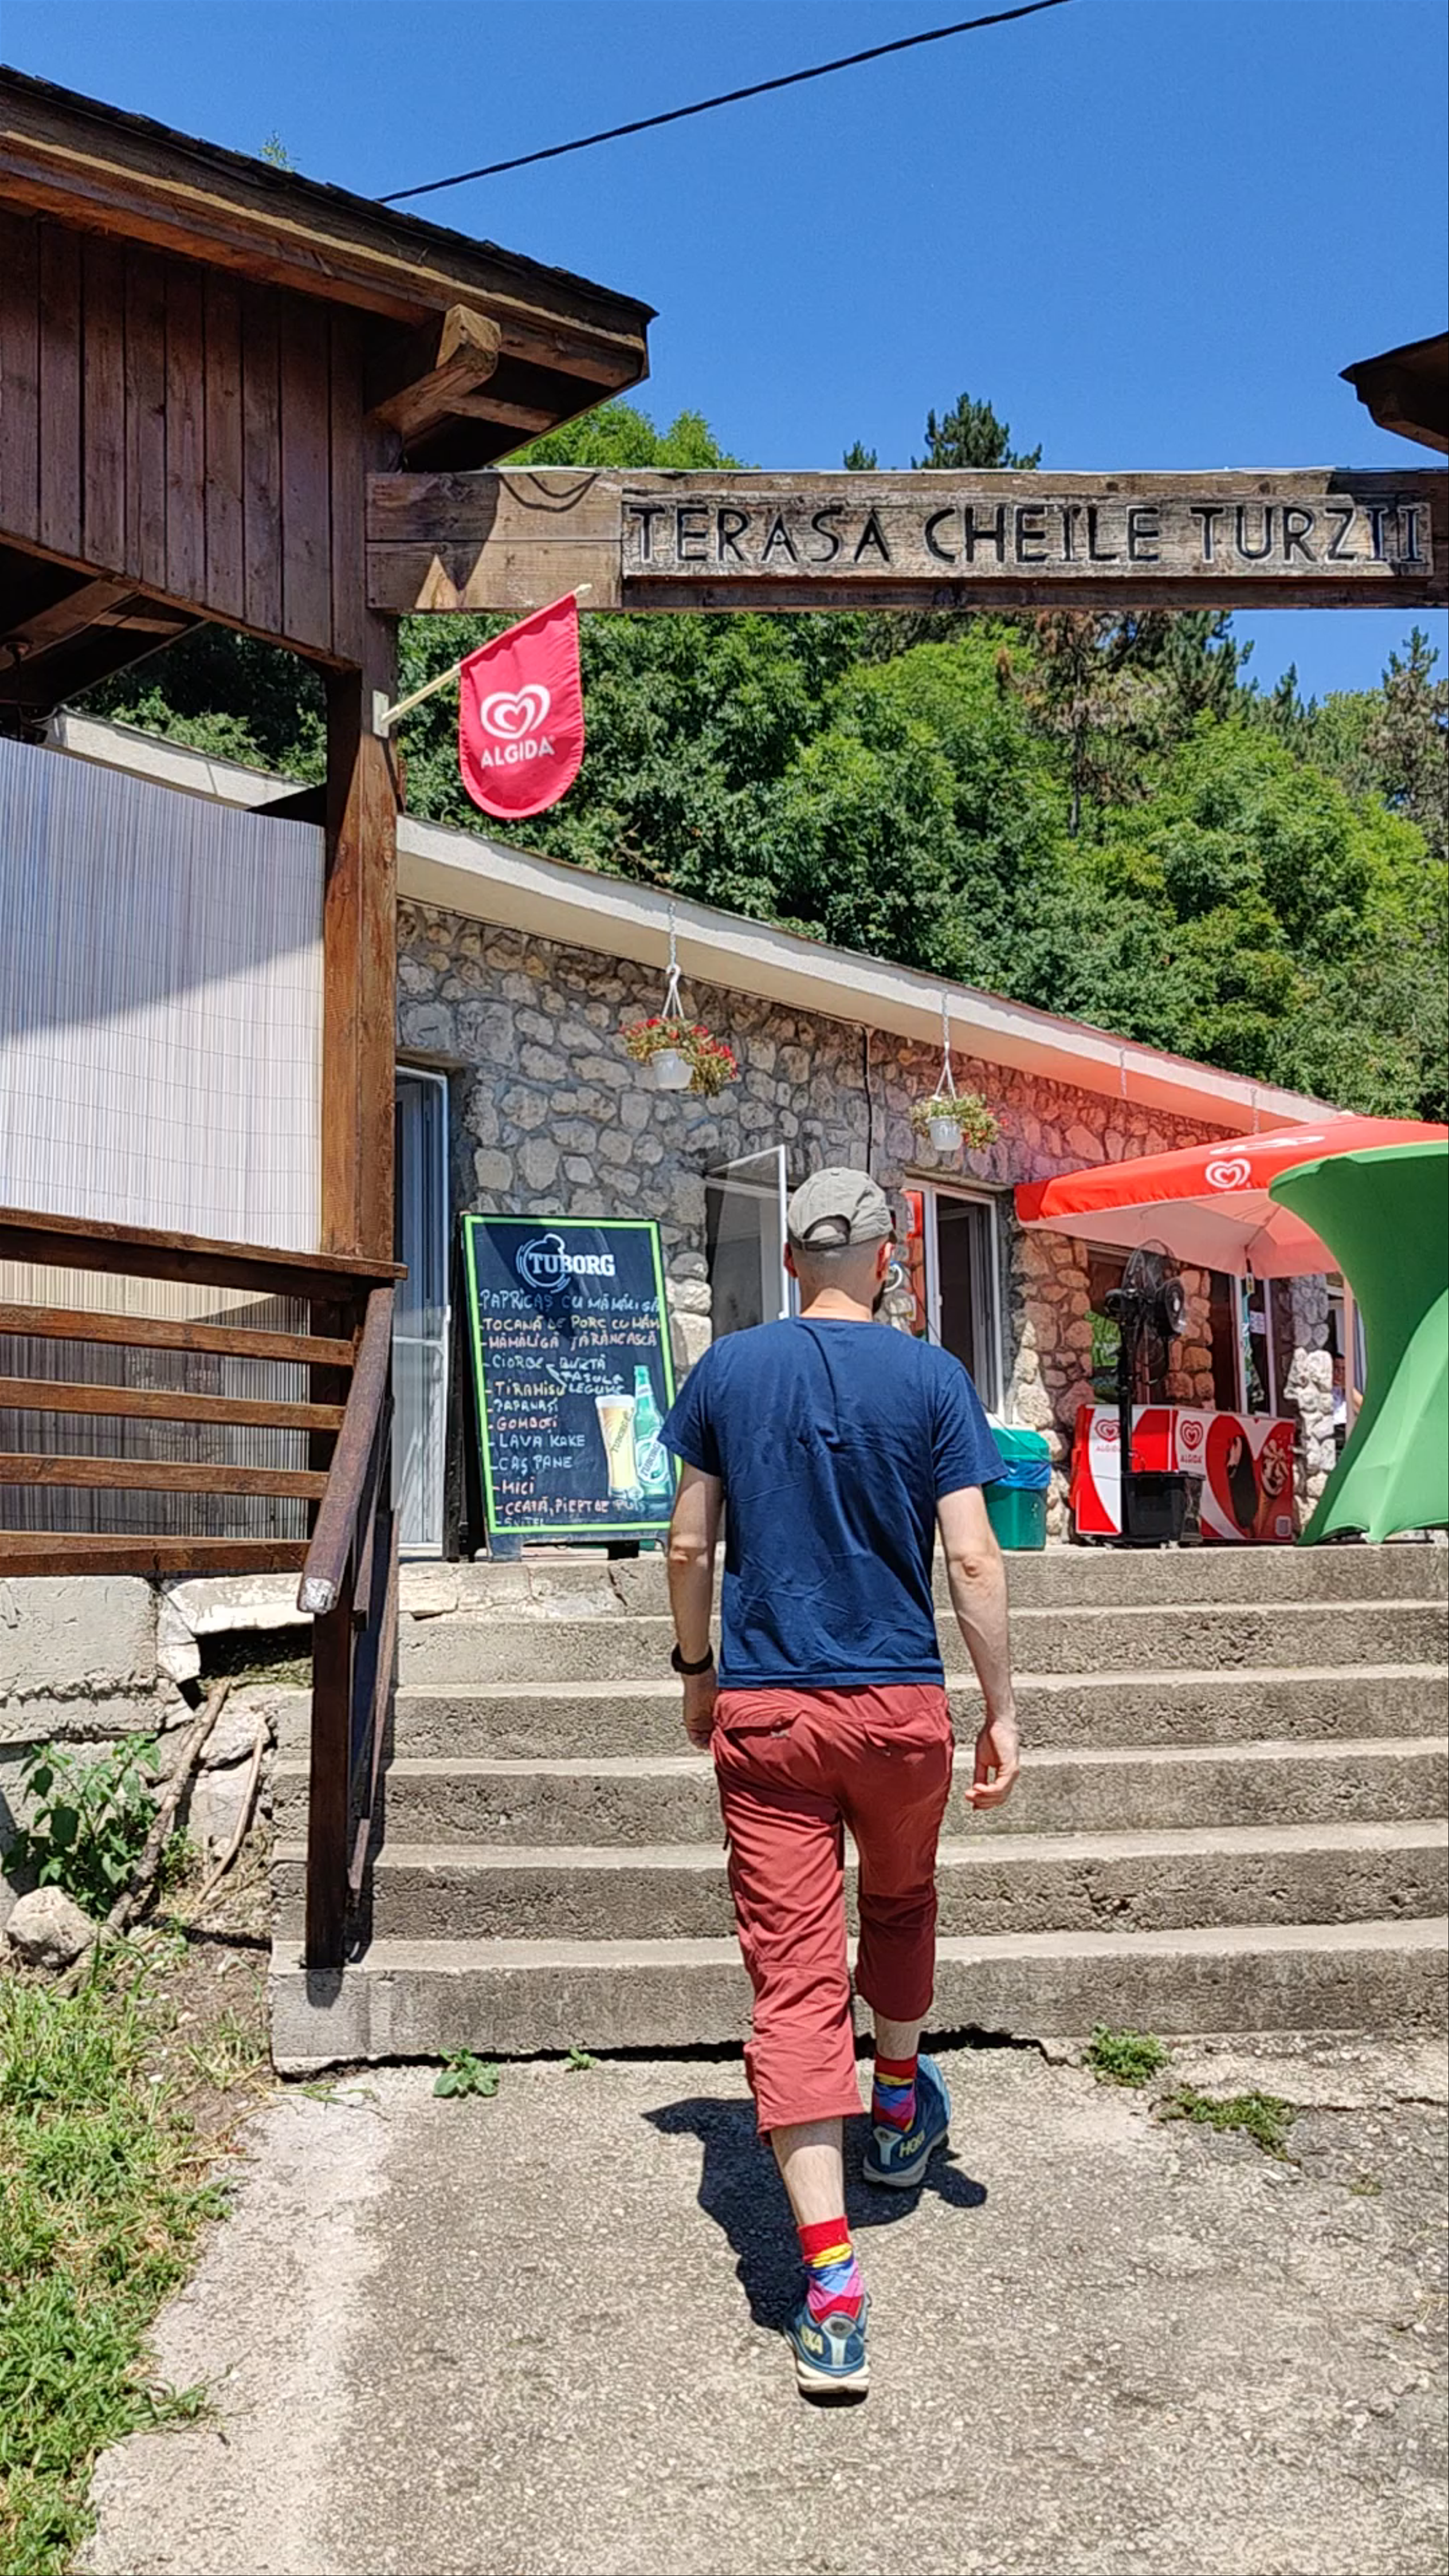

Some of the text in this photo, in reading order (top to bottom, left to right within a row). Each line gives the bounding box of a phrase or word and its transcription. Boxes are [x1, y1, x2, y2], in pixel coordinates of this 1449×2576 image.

[630, 506, 1427, 563] TERASA CHEILE TURZII
[481, 736, 555, 769] ALGIDA
[529, 1253, 616, 1276] TUBORG
[561, 1295, 583, 1309] CU
[547, 1317, 566, 1330] DE
[499, 1433, 586, 1449] LAVA KAKE
[533, 1454, 573, 1469] PANE
